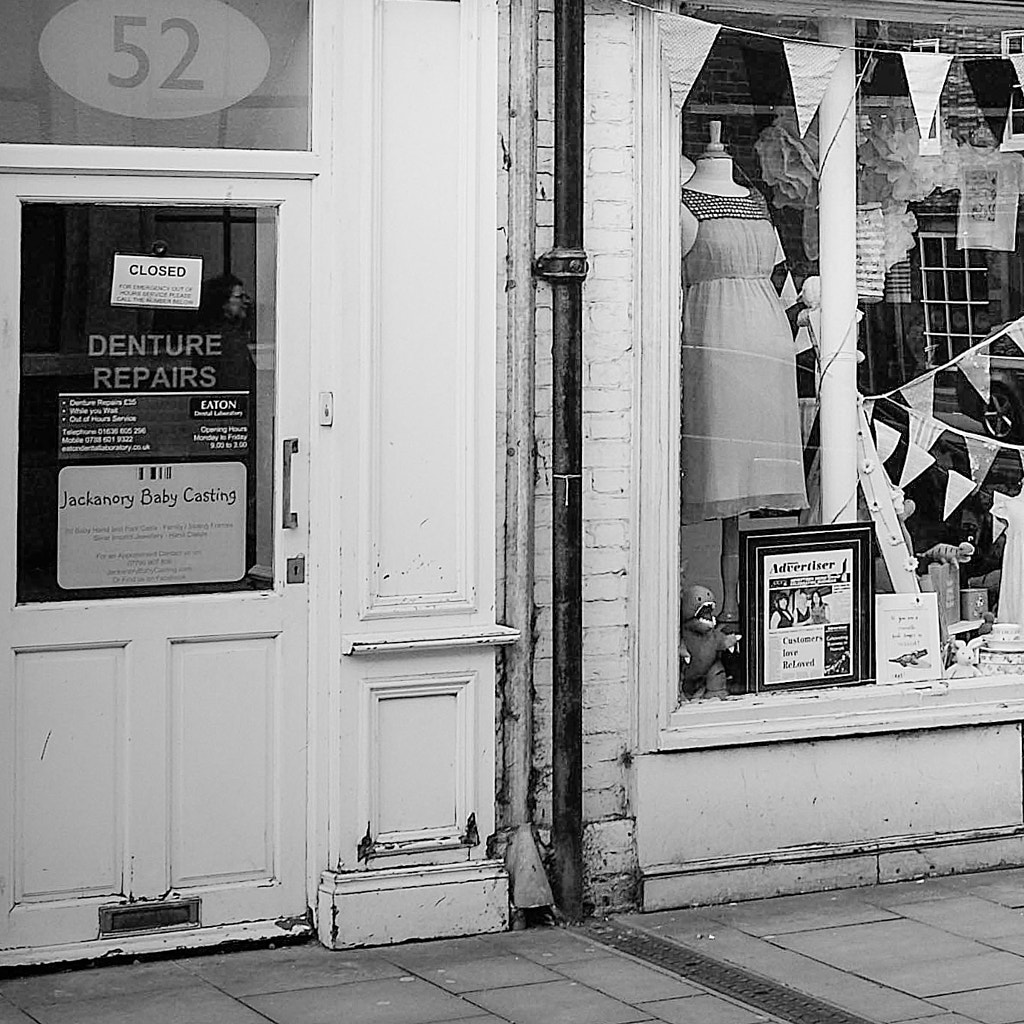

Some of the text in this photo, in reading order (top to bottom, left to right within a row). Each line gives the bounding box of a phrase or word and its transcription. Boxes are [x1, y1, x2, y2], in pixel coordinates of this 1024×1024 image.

[107, 15, 204, 91] 52
[129, 264, 186, 277] CLOSED
[88, 334, 223, 356] DENTURE
[93, 365, 217, 389] REPAIRS
[201, 400, 237, 409] EATON
[59, 487, 237, 509] Jackanory Baby Casting
[769, 560, 836, 574] Advertiser
[782, 636, 823, 645] Customers
[782, 649, 798, 657] love
[782, 658, 815, 669] ReLoved
